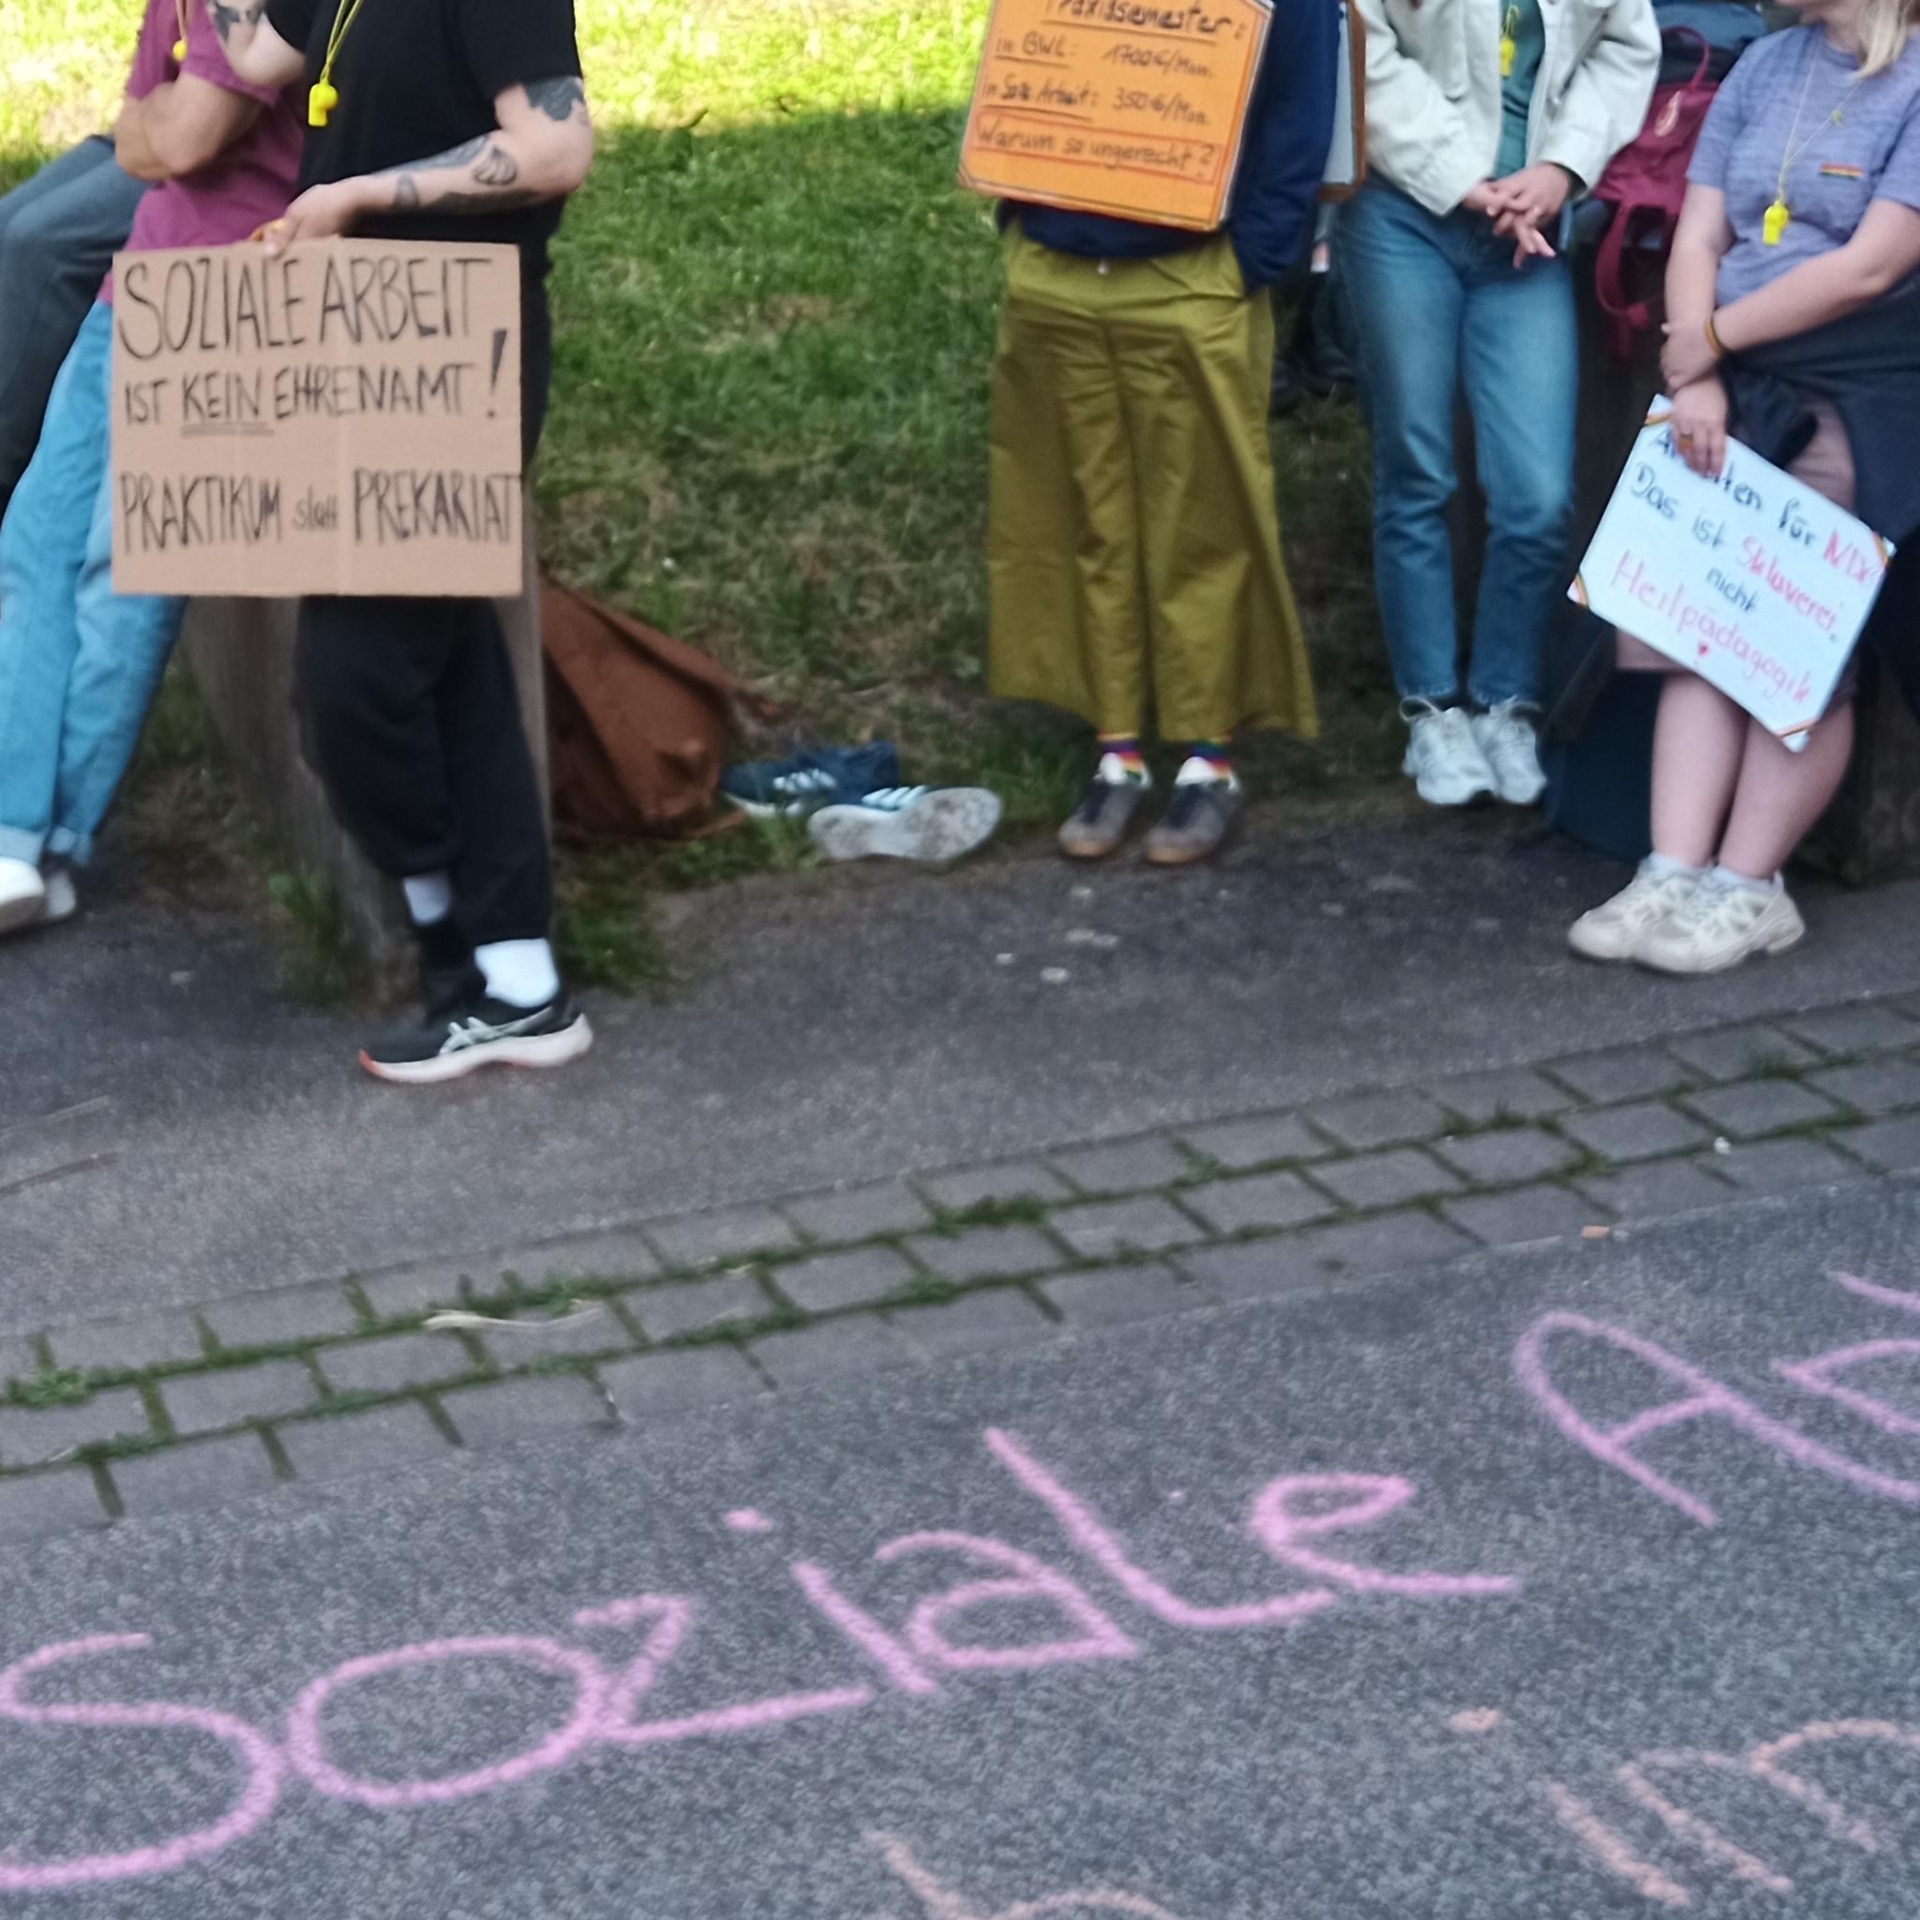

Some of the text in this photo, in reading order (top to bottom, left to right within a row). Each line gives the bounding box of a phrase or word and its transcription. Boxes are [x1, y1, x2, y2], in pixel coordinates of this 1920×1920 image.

[979, 116, 1055, 150] Warum
[1063, 136, 1084, 154] so
[118, 254, 491, 361] SOZIALE ARBEIT
[124, 376, 169, 425] IST
[181, 369, 263, 422] KEIN
[119, 466, 521, 554] PRAKTIKUM statt PREKARIAT
[1630, 461, 1679, 520] Das
[1691, 509, 1727, 551] ist
[1778, 497, 1817, 546] für
[1609, 548, 1810, 703] Heilpädagogik
[1705, 567, 1758, 614] nicht
